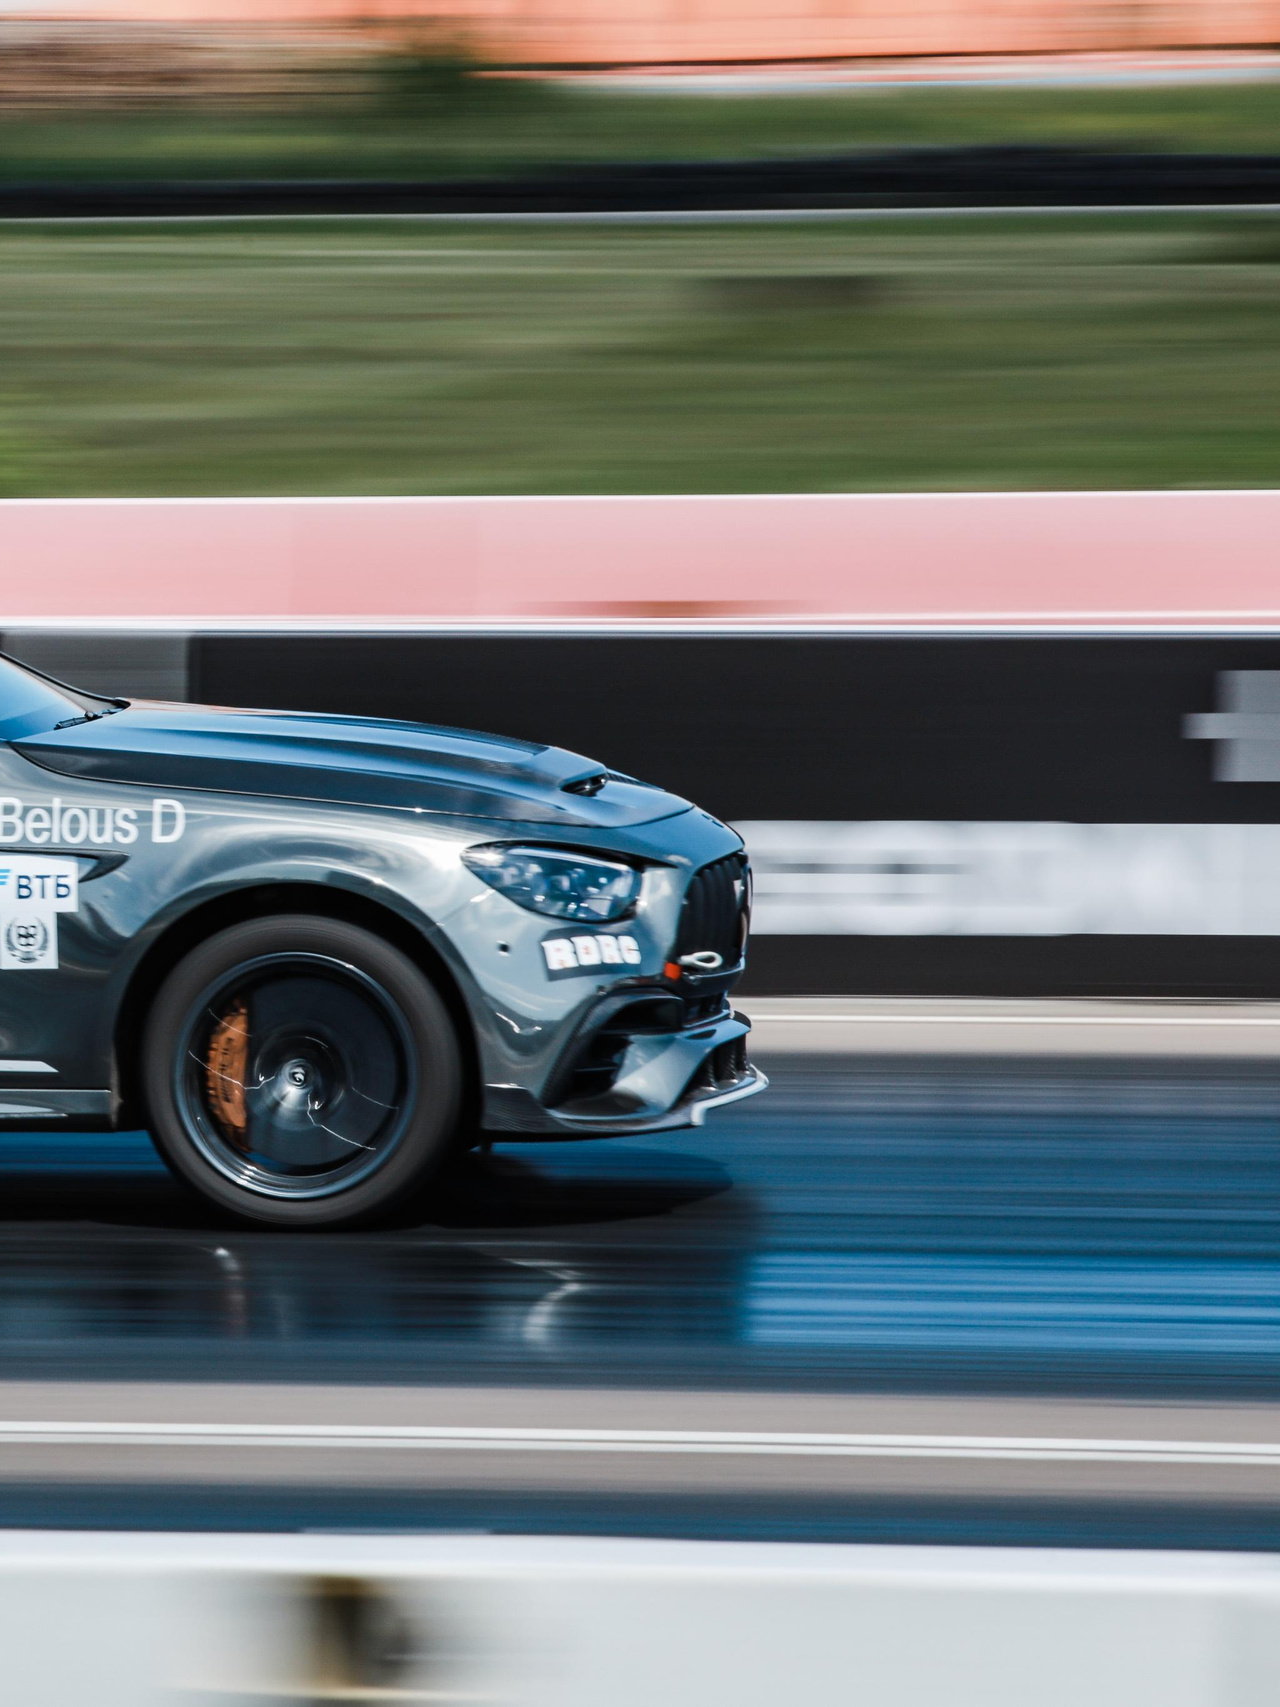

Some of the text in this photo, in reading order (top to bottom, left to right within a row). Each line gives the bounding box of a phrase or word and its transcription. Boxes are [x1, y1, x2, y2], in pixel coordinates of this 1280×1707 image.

[151, 798, 186, 844] D
[16, 874, 71, 900] ВТБ
[540, 934, 642, 971] RDRC
